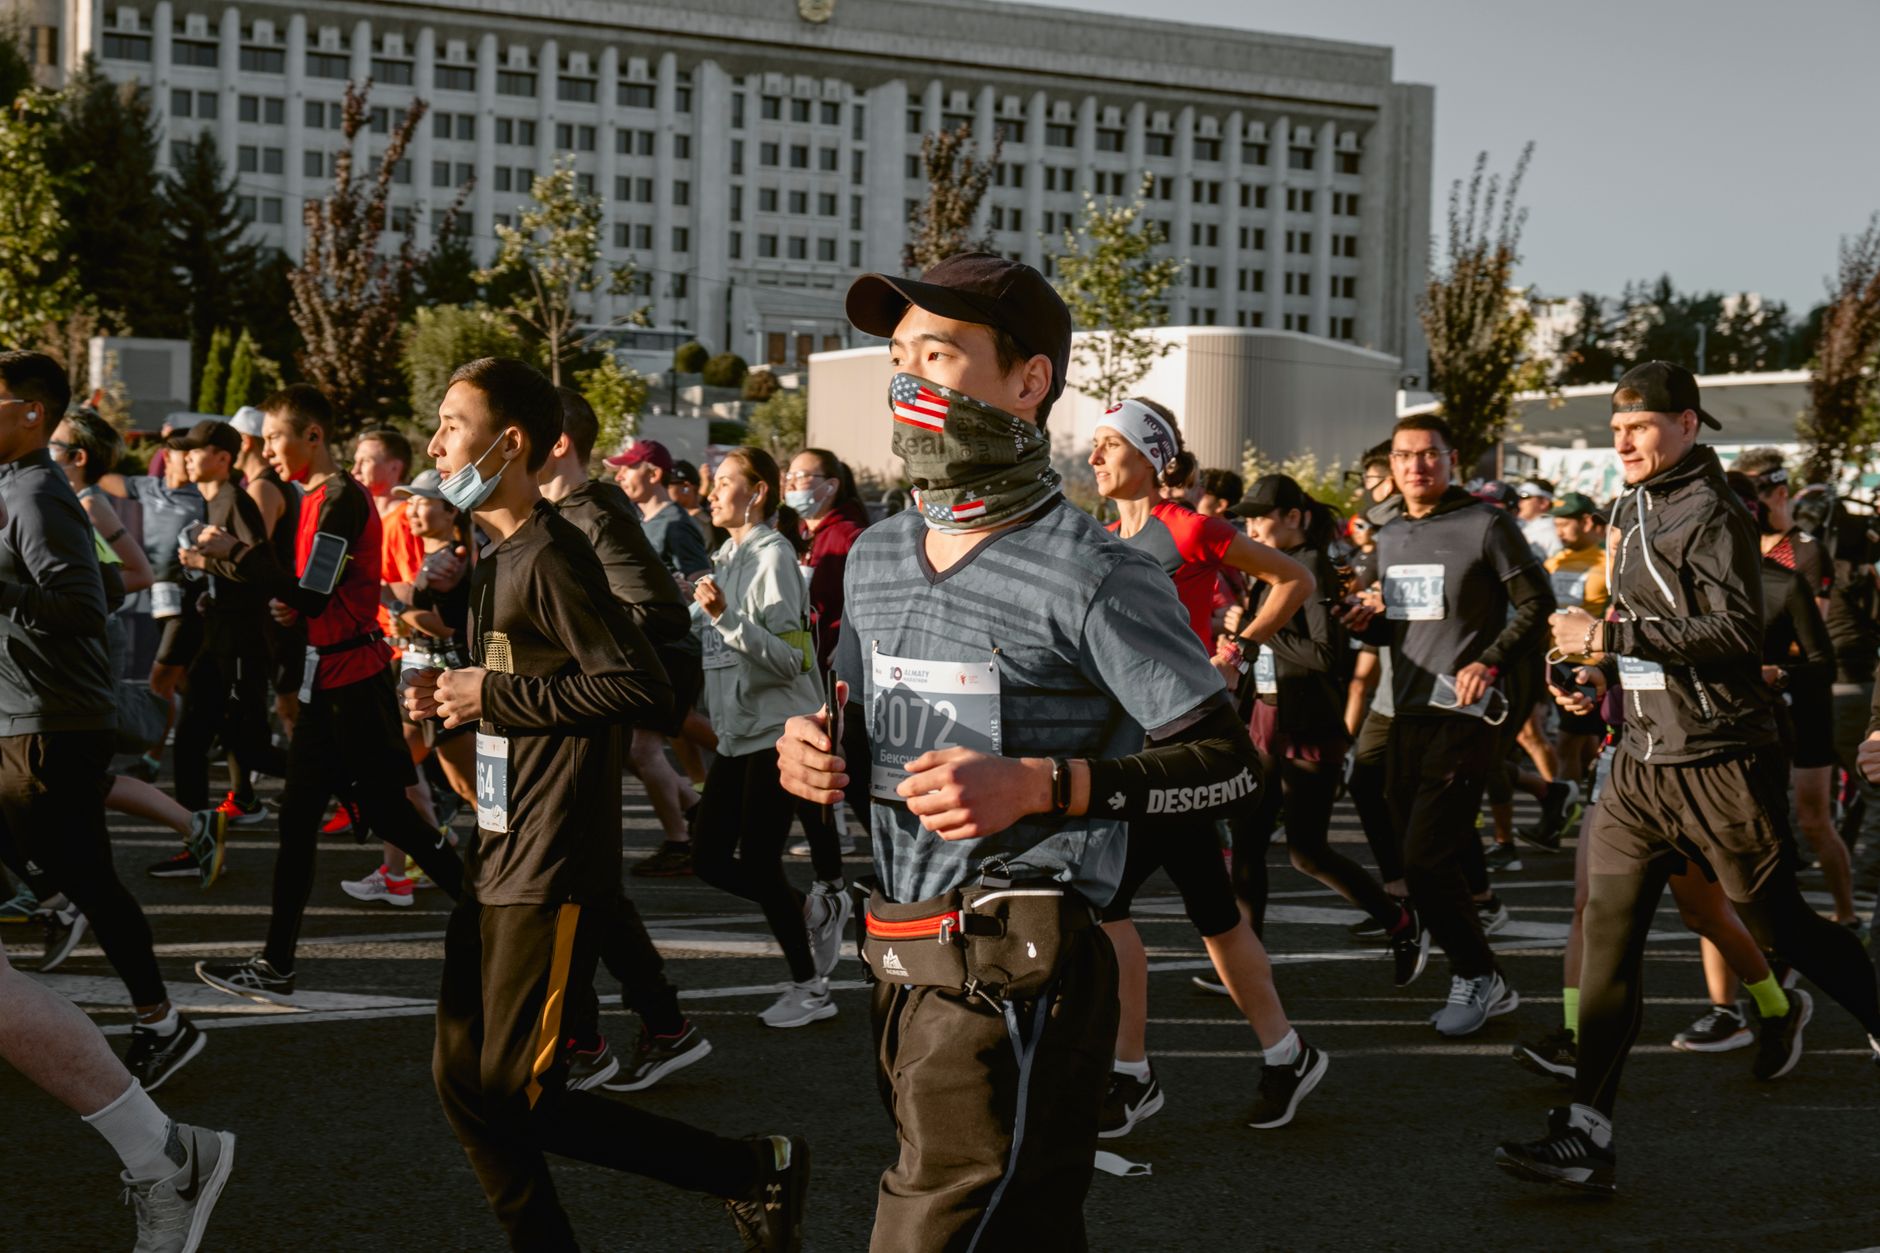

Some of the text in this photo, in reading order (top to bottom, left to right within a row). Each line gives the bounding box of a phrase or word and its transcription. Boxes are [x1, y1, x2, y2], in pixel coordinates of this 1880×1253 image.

[874, 691, 958, 749] 3072
[990, 720, 999, 738] 21.1
[880, 748, 919, 765] Бексу
[1146, 766, 1258, 813] DESCENTE
